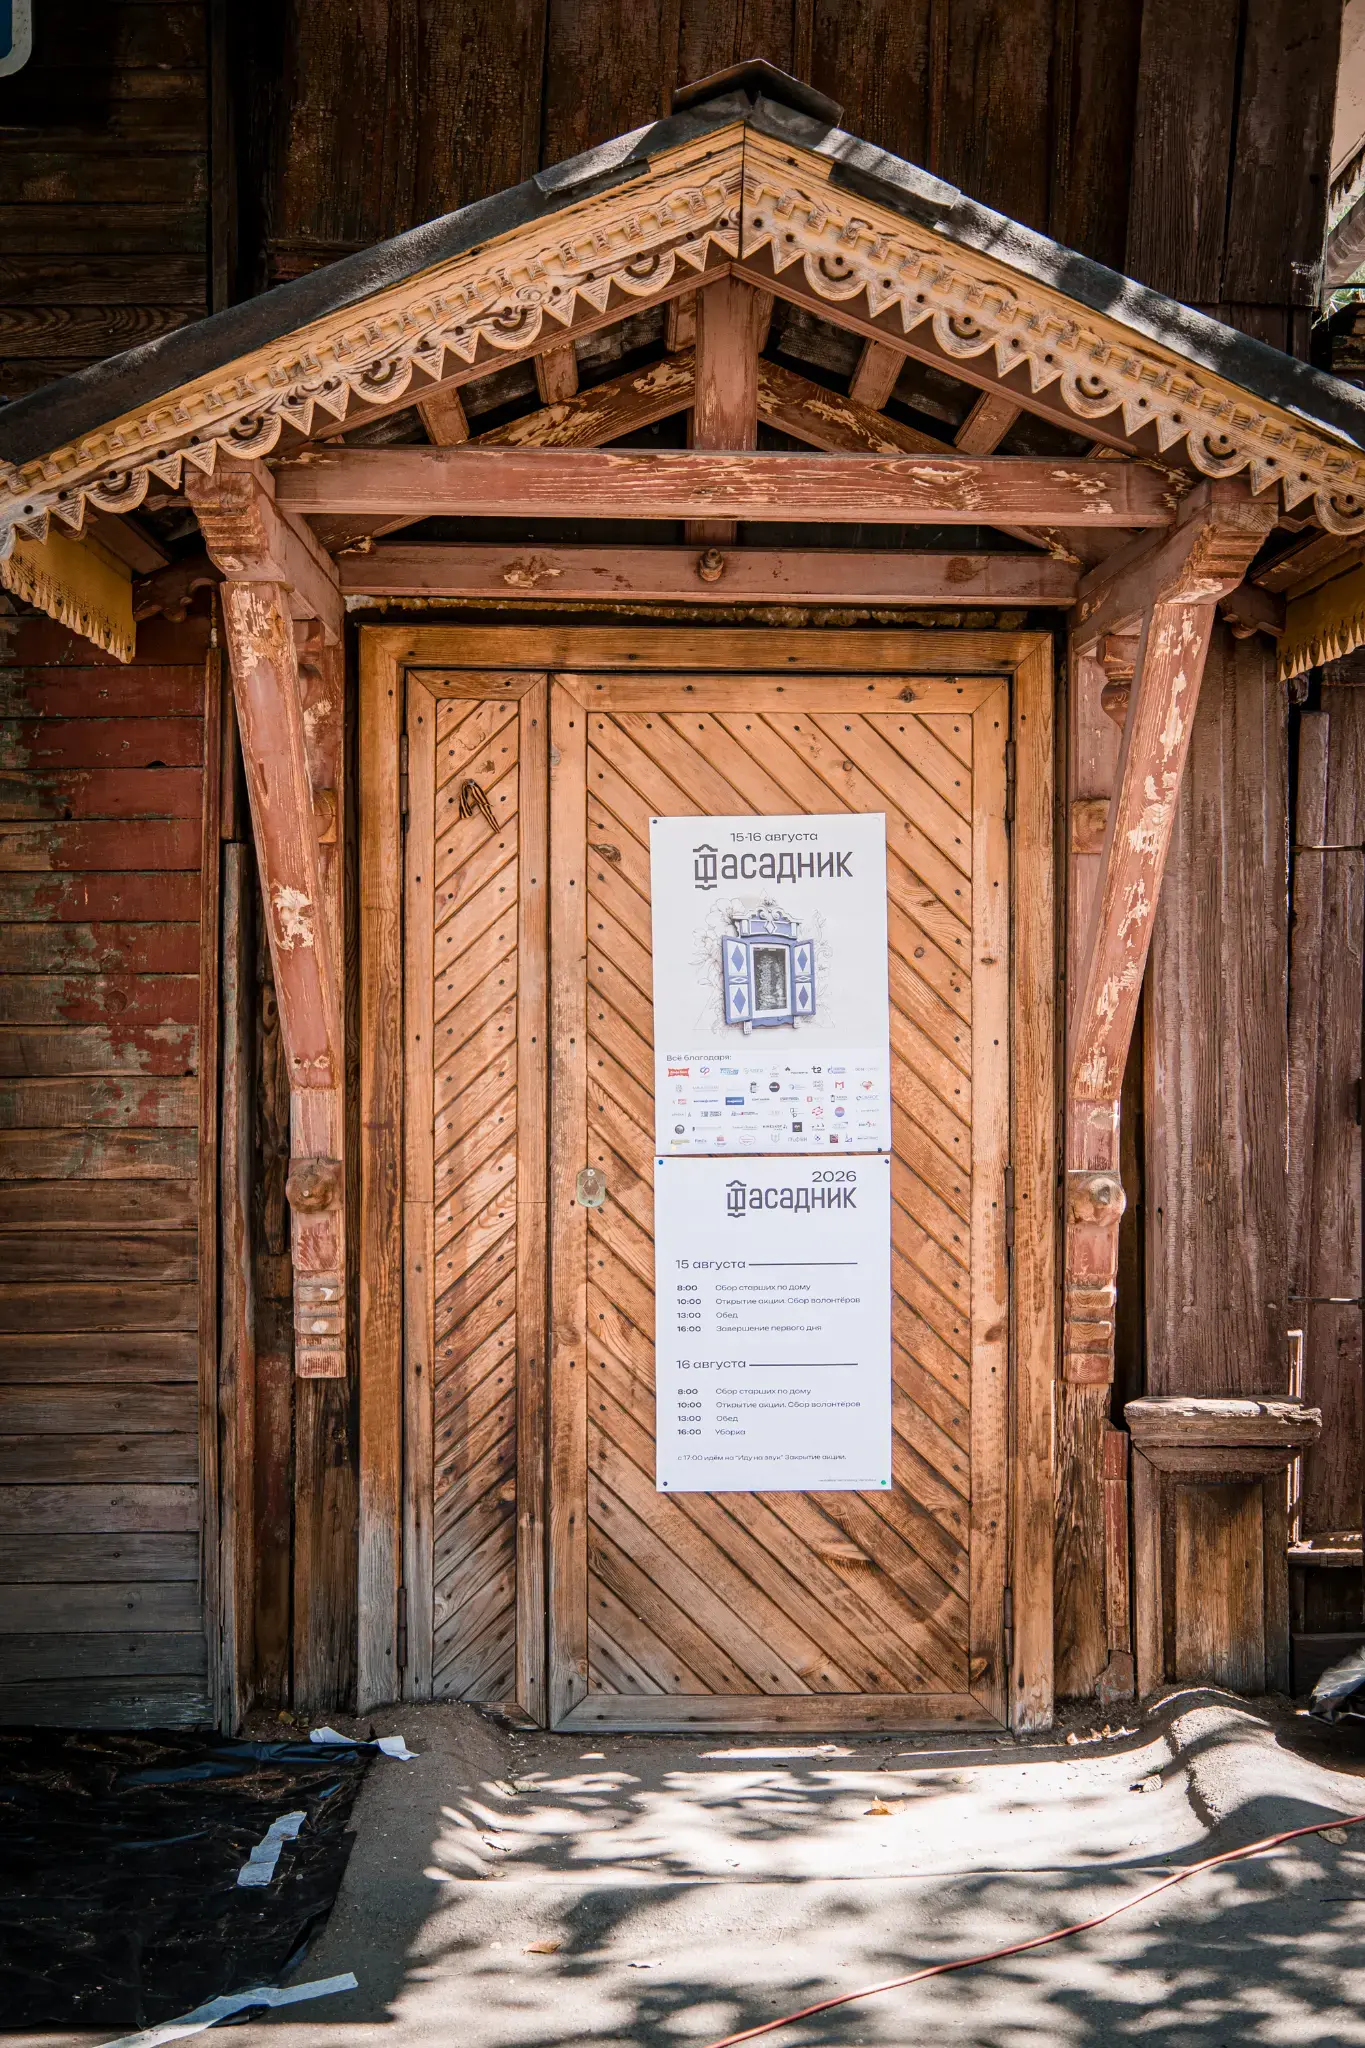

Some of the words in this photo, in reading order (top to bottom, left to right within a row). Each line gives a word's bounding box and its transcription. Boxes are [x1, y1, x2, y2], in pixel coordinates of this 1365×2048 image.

[729, 832, 762, 843] 15-16
[764, 832, 818, 843] августа
[666, 1054, 683, 1062] Всё
[683, 1054, 732, 1062] благодаря:
[811, 1065, 822, 1074] t2
[811, 1170, 857, 1183] 2026
[675, 1259, 690, 1270] 15
[692, 1260, 746, 1271] августа
[676, 1284, 698, 1292] 8:00
[714, 1284, 738, 1292] Сбор
[715, 1298, 757, 1306] Открытие
[787, 1297, 810, 1305] Сбор
[715, 1311, 739, 1319] Обед
[676, 1325, 702, 1333] 16:00
[716, 1325, 770, 1333] Завершение
[770, 1325, 805, 1333] первого
[675, 1359, 691, 1370] 16
[692, 1360, 747, 1371] августа
[677, 1388, 699, 1396] 8:00
[715, 1387, 738, 1396] Сбор
[788, 1388, 812, 1396] дому
[677, 1401, 702, 1409] 10:00
[715, 1401, 758, 1409] Открытие
[787, 1401, 810, 1409] Сбор
[715, 1415, 739, 1423] Обед
[677, 1428, 702, 1436] 16:00
[714, 1428, 746, 1437] Уборка
